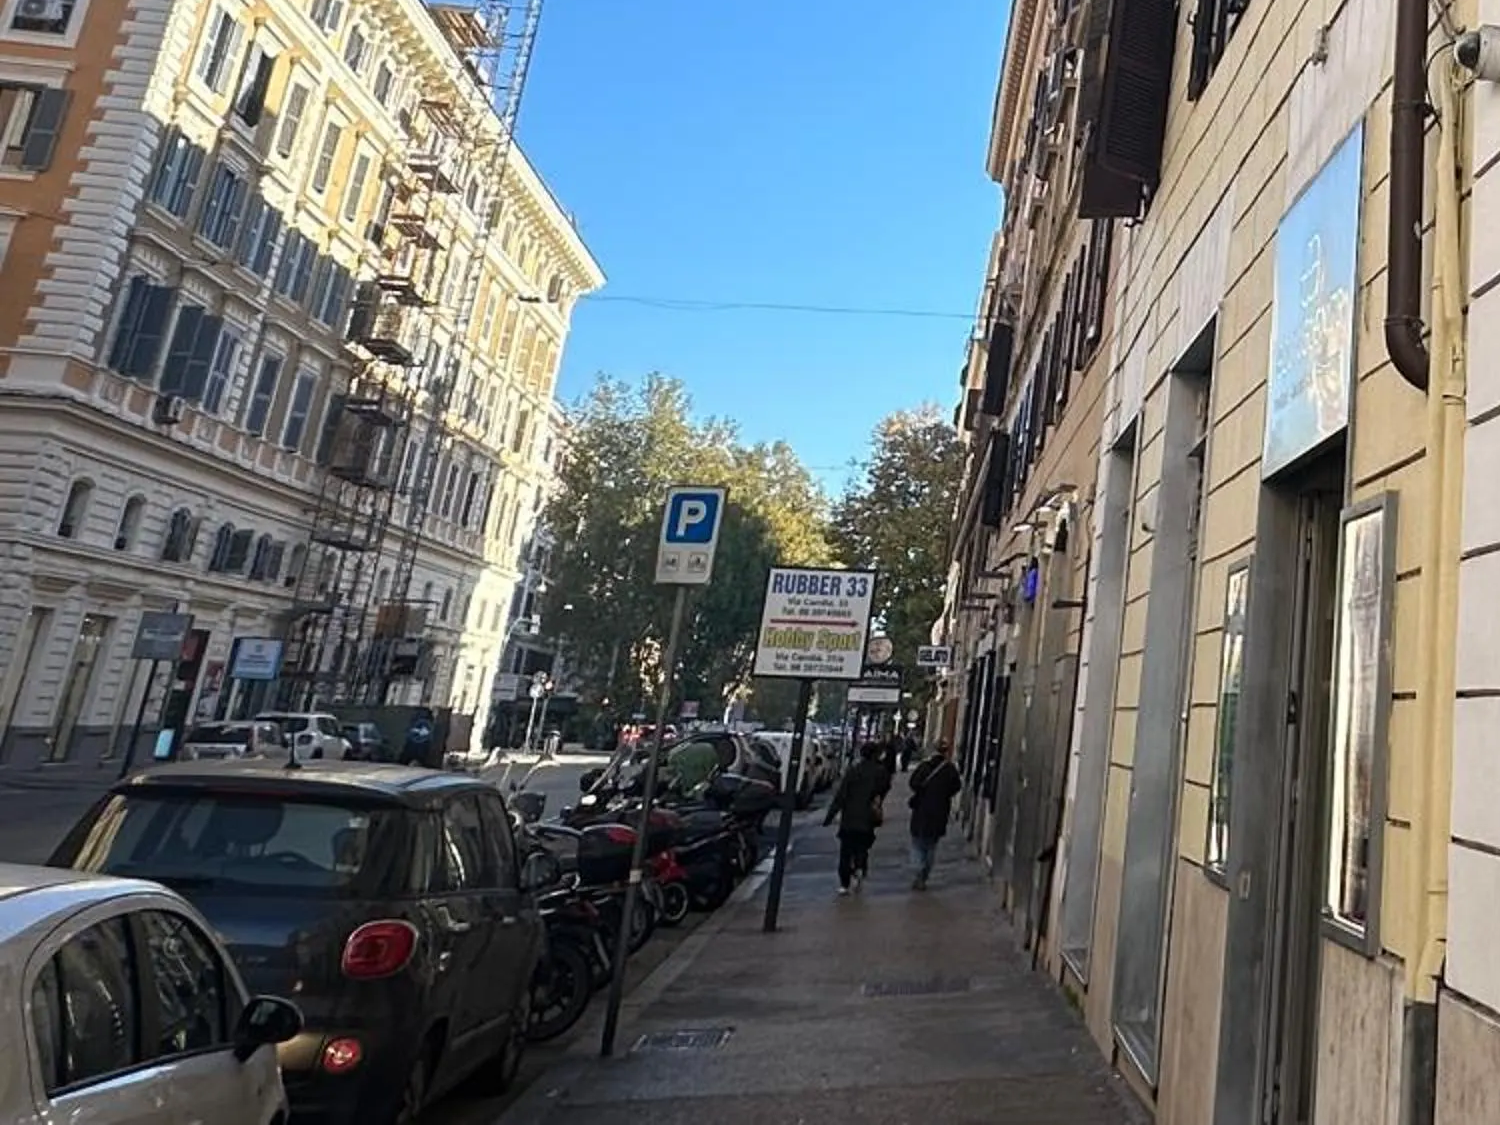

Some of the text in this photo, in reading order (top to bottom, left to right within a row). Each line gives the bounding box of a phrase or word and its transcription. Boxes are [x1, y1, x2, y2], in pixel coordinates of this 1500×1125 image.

[676, 499, 707, 537] P
[772, 572, 868, 597] RUBBER 33
